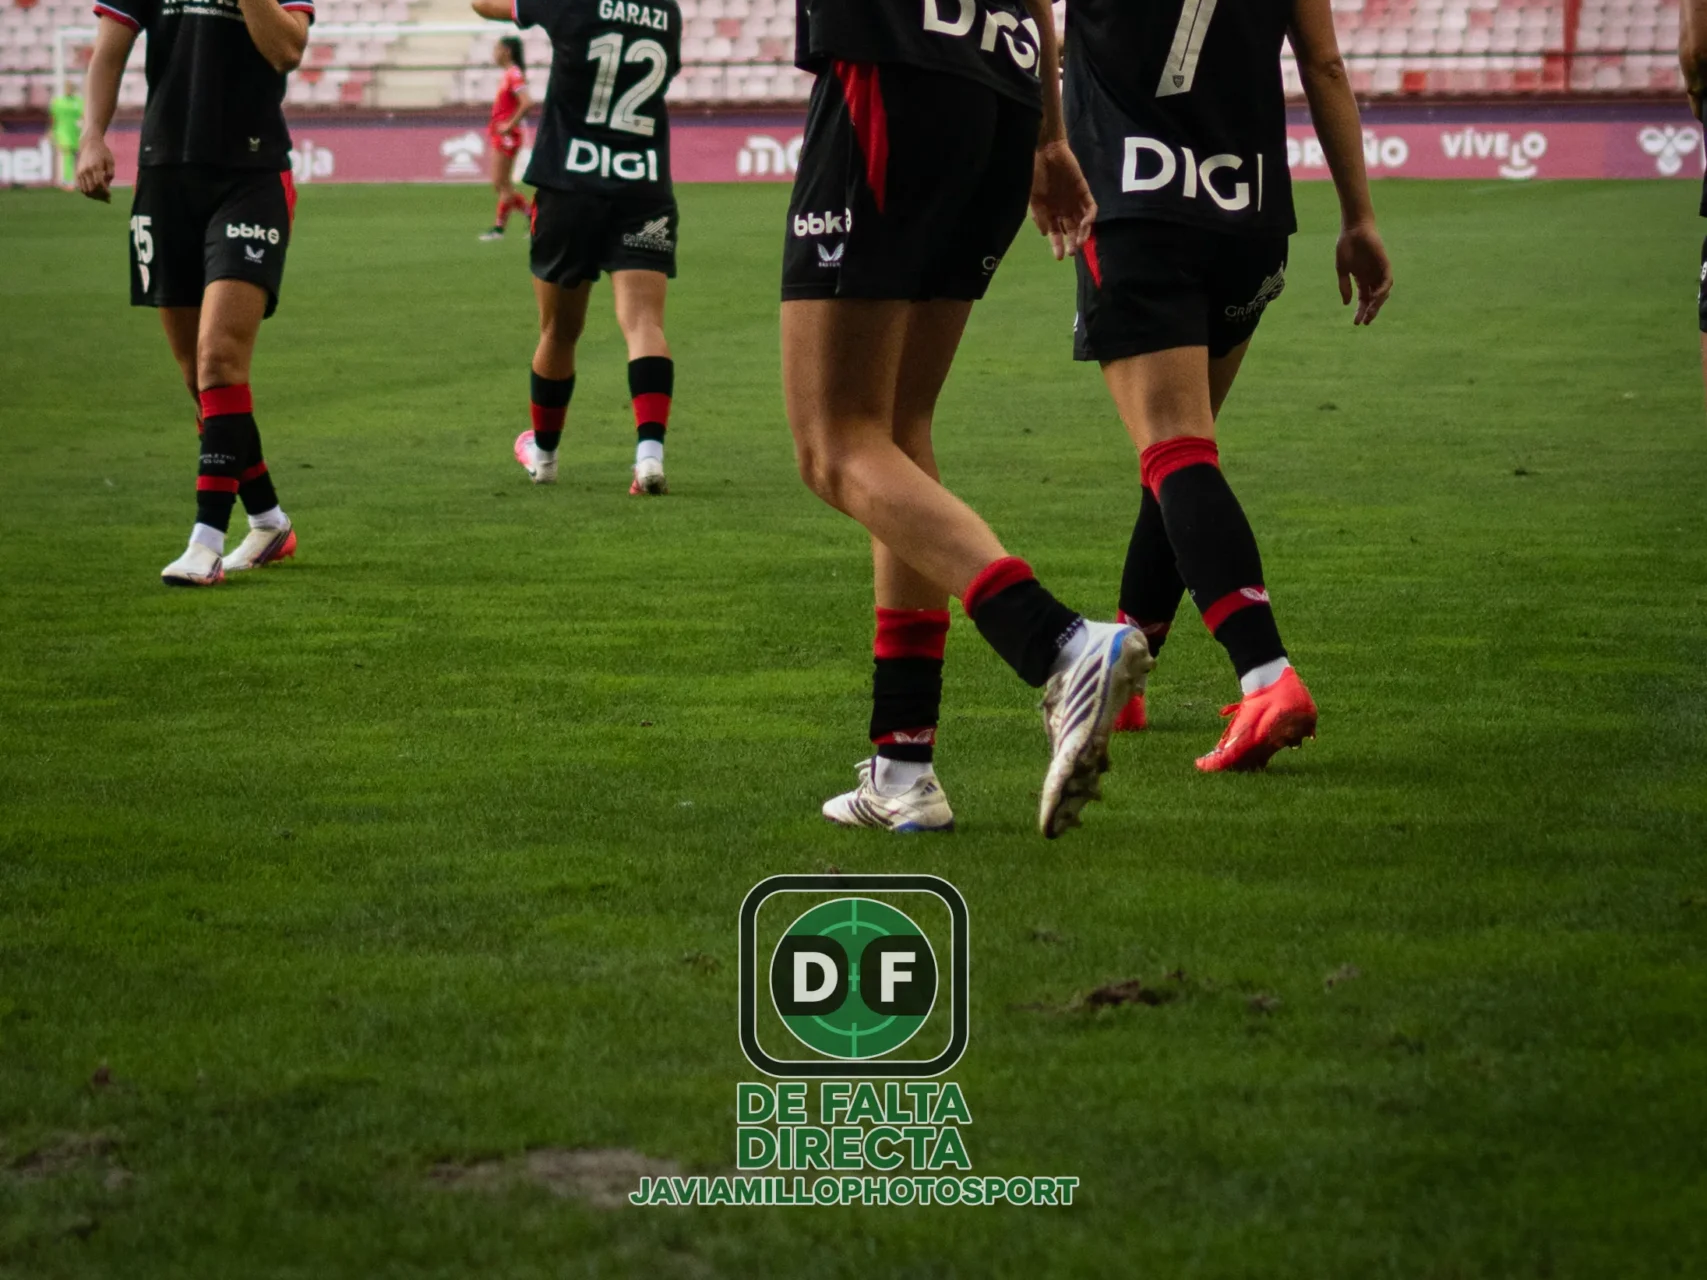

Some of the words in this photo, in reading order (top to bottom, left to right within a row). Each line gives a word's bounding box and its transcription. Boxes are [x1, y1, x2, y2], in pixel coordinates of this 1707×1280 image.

[585, 31, 669, 137] 12
[565, 137, 659, 182] DIGI
[1121, 136, 1263, 211] DIGI
[226, 222, 267, 241] bbk
[793, 210, 845, 237] bbk
